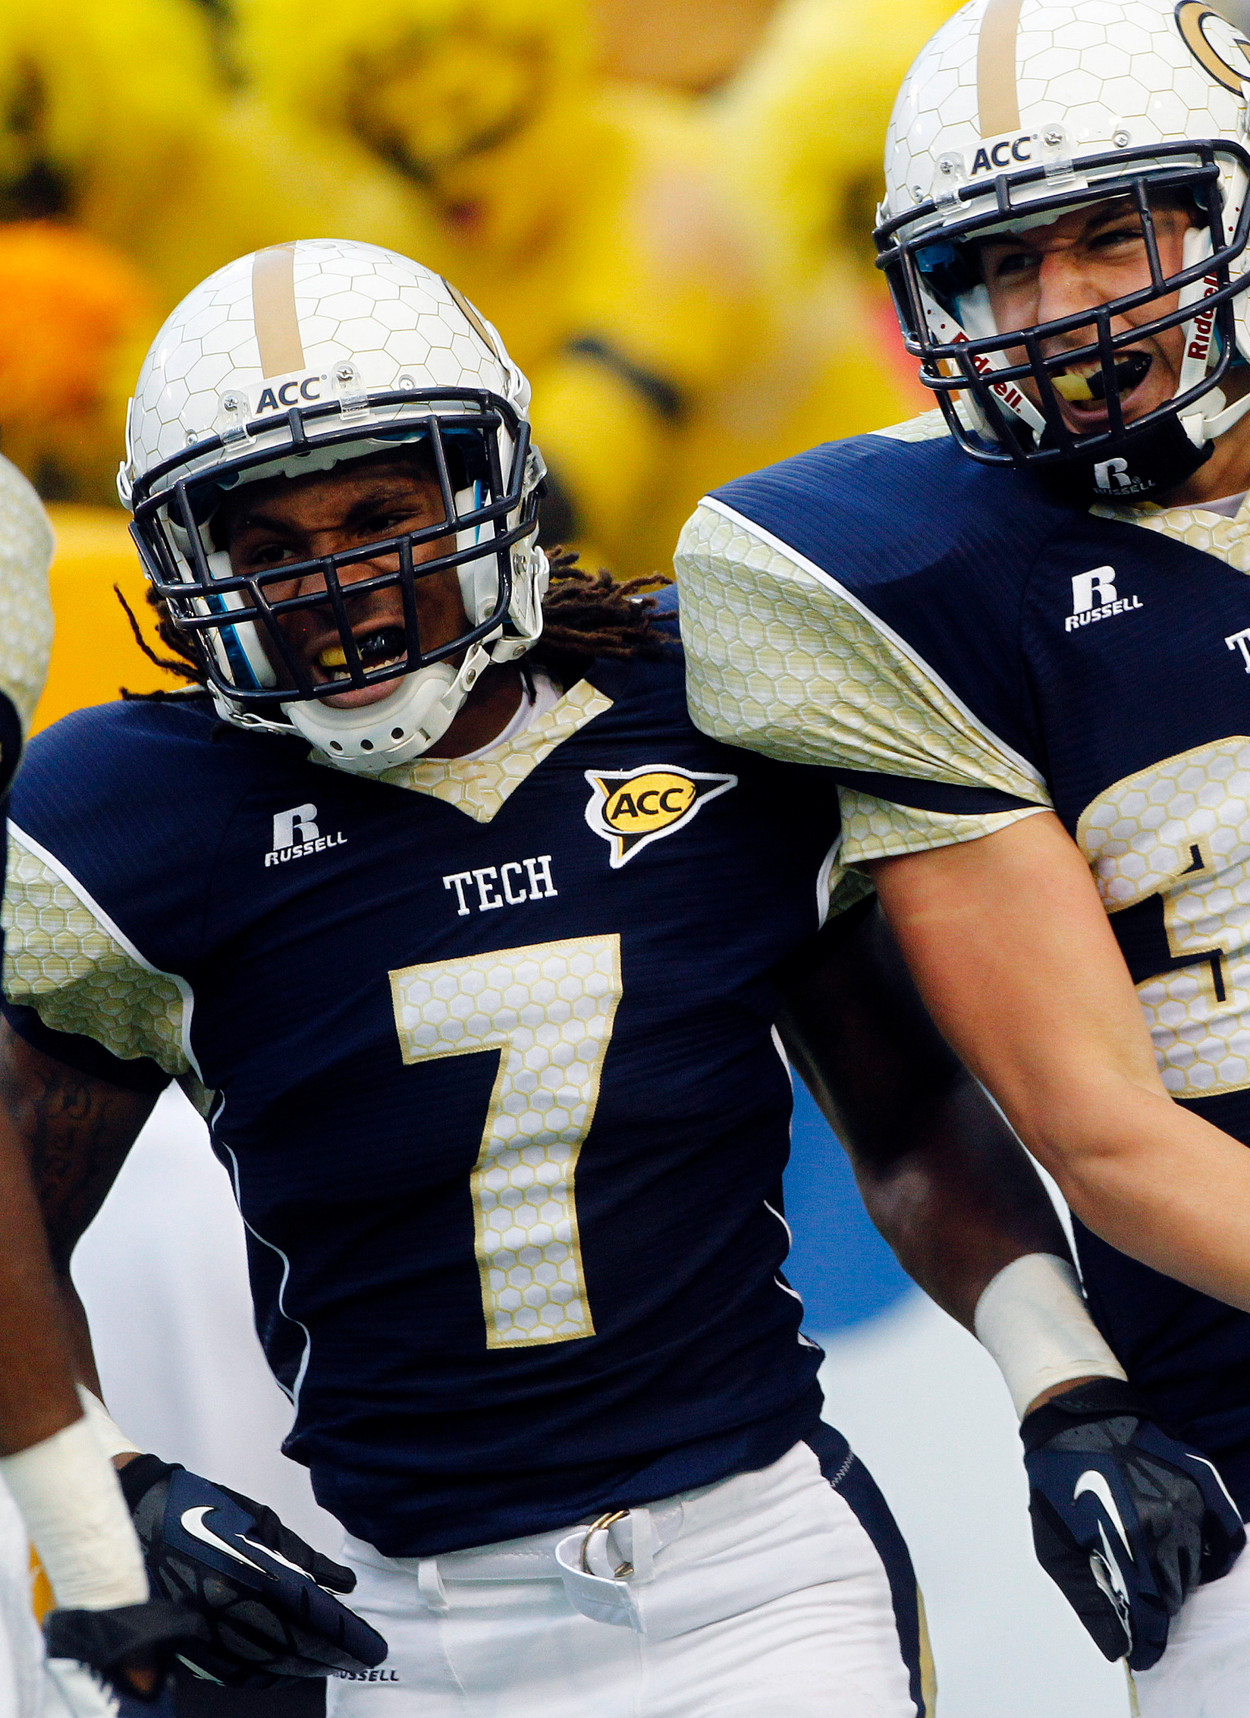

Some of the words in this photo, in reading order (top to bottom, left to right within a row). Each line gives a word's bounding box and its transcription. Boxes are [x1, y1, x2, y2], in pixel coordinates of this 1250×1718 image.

[970, 136, 1031, 175] ACC
[255, 376, 320, 414] ACC
[1071, 565, 1118, 615] R
[1065, 594, 1144, 633] RUSSELL
[610, 788, 684, 820] ACC
[273, 803, 319, 851] R
[264, 831, 348, 868] RUSSELL
[443, 855, 558, 916] TECH
[388, 933, 623, 1349] 7
[332, 1669, 399, 1682] USSELL
